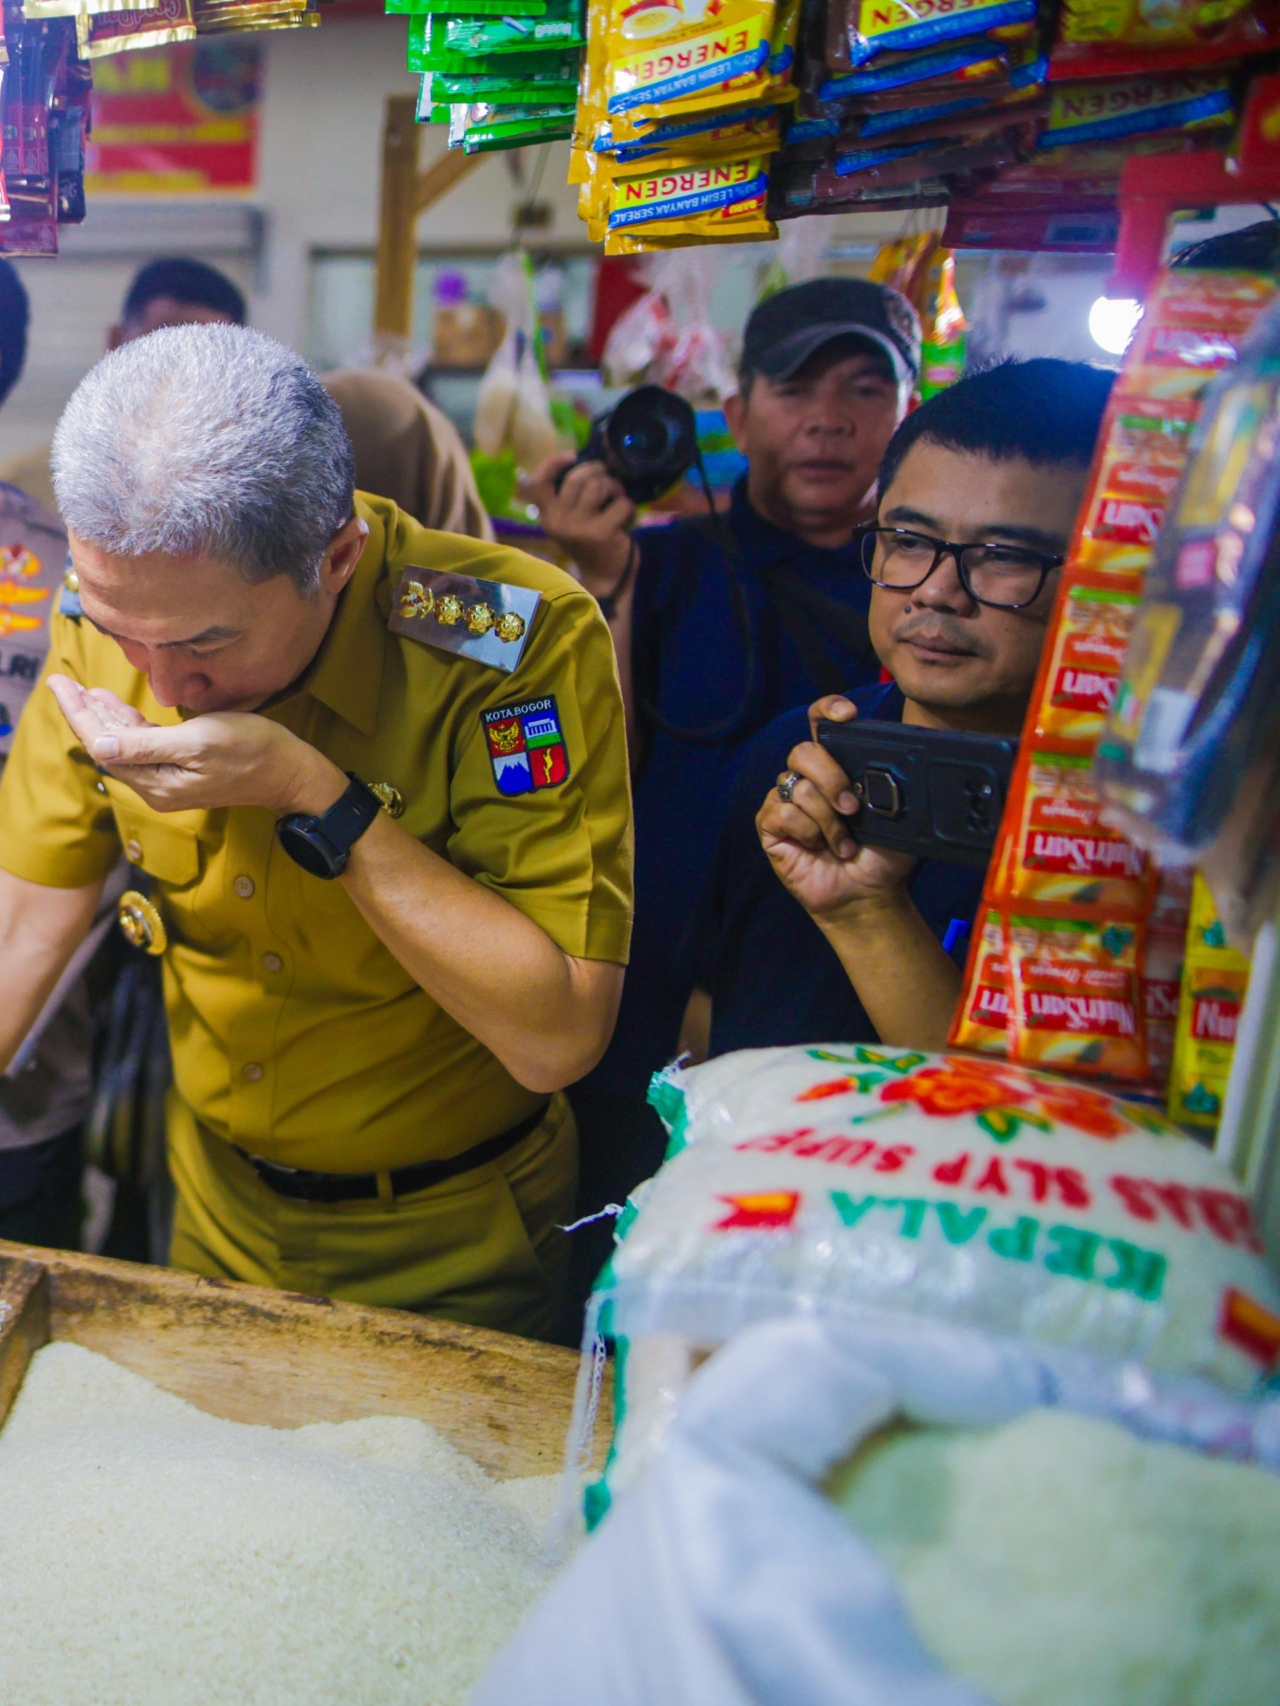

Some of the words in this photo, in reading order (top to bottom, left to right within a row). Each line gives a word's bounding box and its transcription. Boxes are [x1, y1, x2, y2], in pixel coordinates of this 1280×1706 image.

[699, 62, 731, 81] LEBIH
[656, 74, 697, 96] BANYAK
[626, 159, 749, 201] ENERGEN
[656, 196, 699, 216] BANYAK
[701, 188, 733, 206] LEBIH
[729, 199, 757, 214] BARU
[615, 206, 654, 224] SEREAL
[485, 708, 513, 722] KOTA
[514, 699, 552, 715] BOGOR
[1030, 993, 1135, 1035] NutriSari
[933, 1150, 1092, 1211] SLYP
[828, 1188, 1168, 1301] KEPALA
